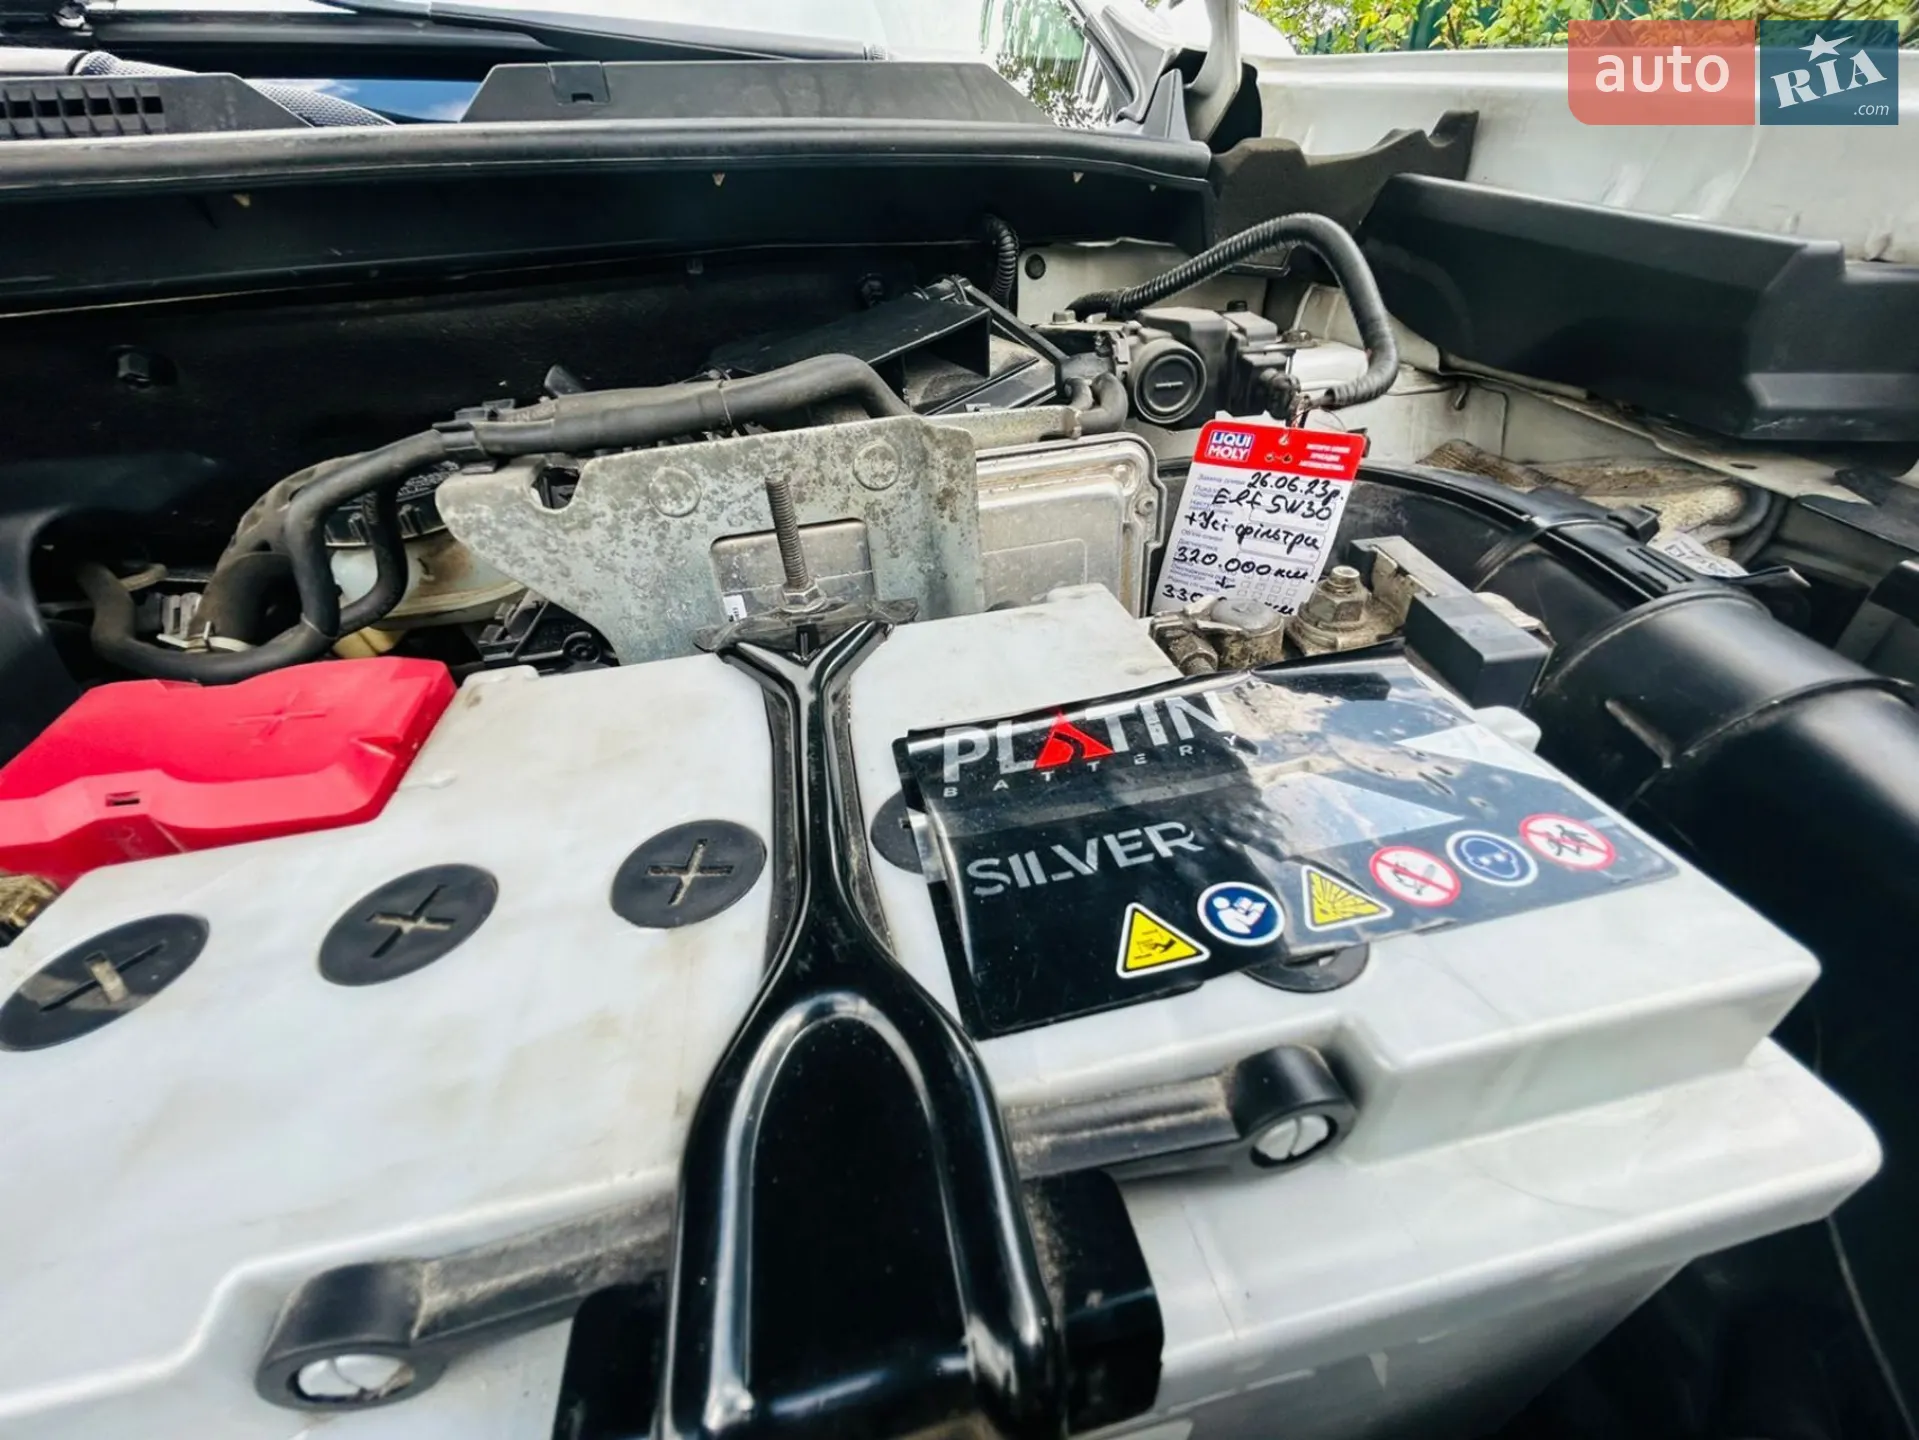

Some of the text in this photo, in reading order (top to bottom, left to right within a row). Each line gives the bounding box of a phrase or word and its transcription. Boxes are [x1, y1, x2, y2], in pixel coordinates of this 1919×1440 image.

[1207, 445, 1250, 461] MOLY
[1212, 431, 1252, 448] LIQUI
[942, 691, 1235, 783] PLATIN
[943, 734, 1237, 798] BATTERY
[966, 821, 1205, 897] SILVER
